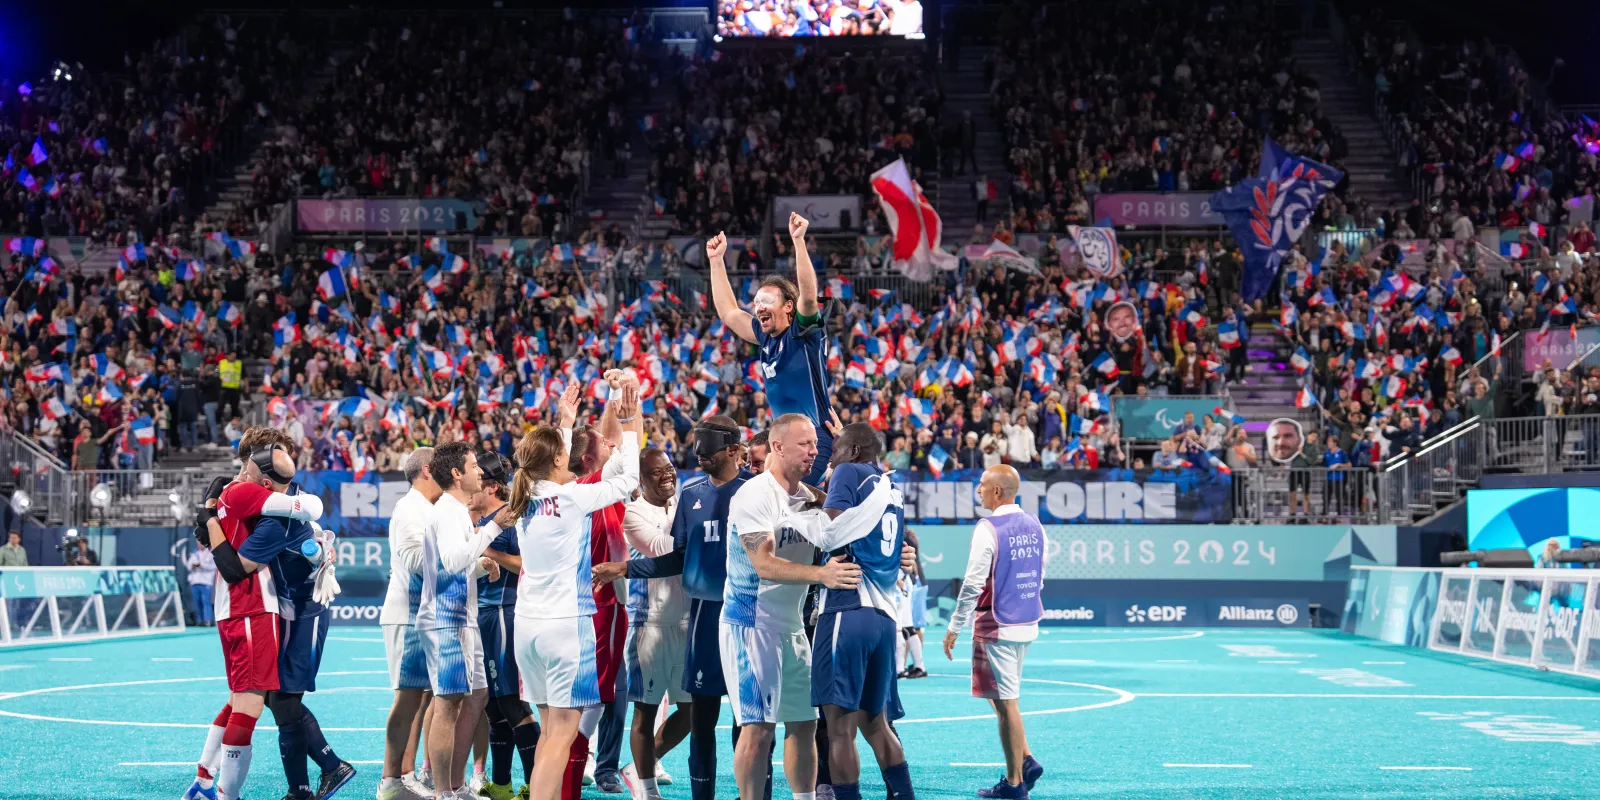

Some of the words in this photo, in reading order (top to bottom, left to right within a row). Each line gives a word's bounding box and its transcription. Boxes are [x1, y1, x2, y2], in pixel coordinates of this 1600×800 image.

[703, 520, 720, 542] 11
[881, 512, 899, 558] 9
[1010, 546, 1040, 560] 2024
[1173, 540, 1276, 565] 2024
[1016, 581, 1038, 590] TOYOTA
[330, 605, 384, 620] TOYO
[1218, 605, 1275, 621] Allianz
[488, 659, 498, 679] 3
